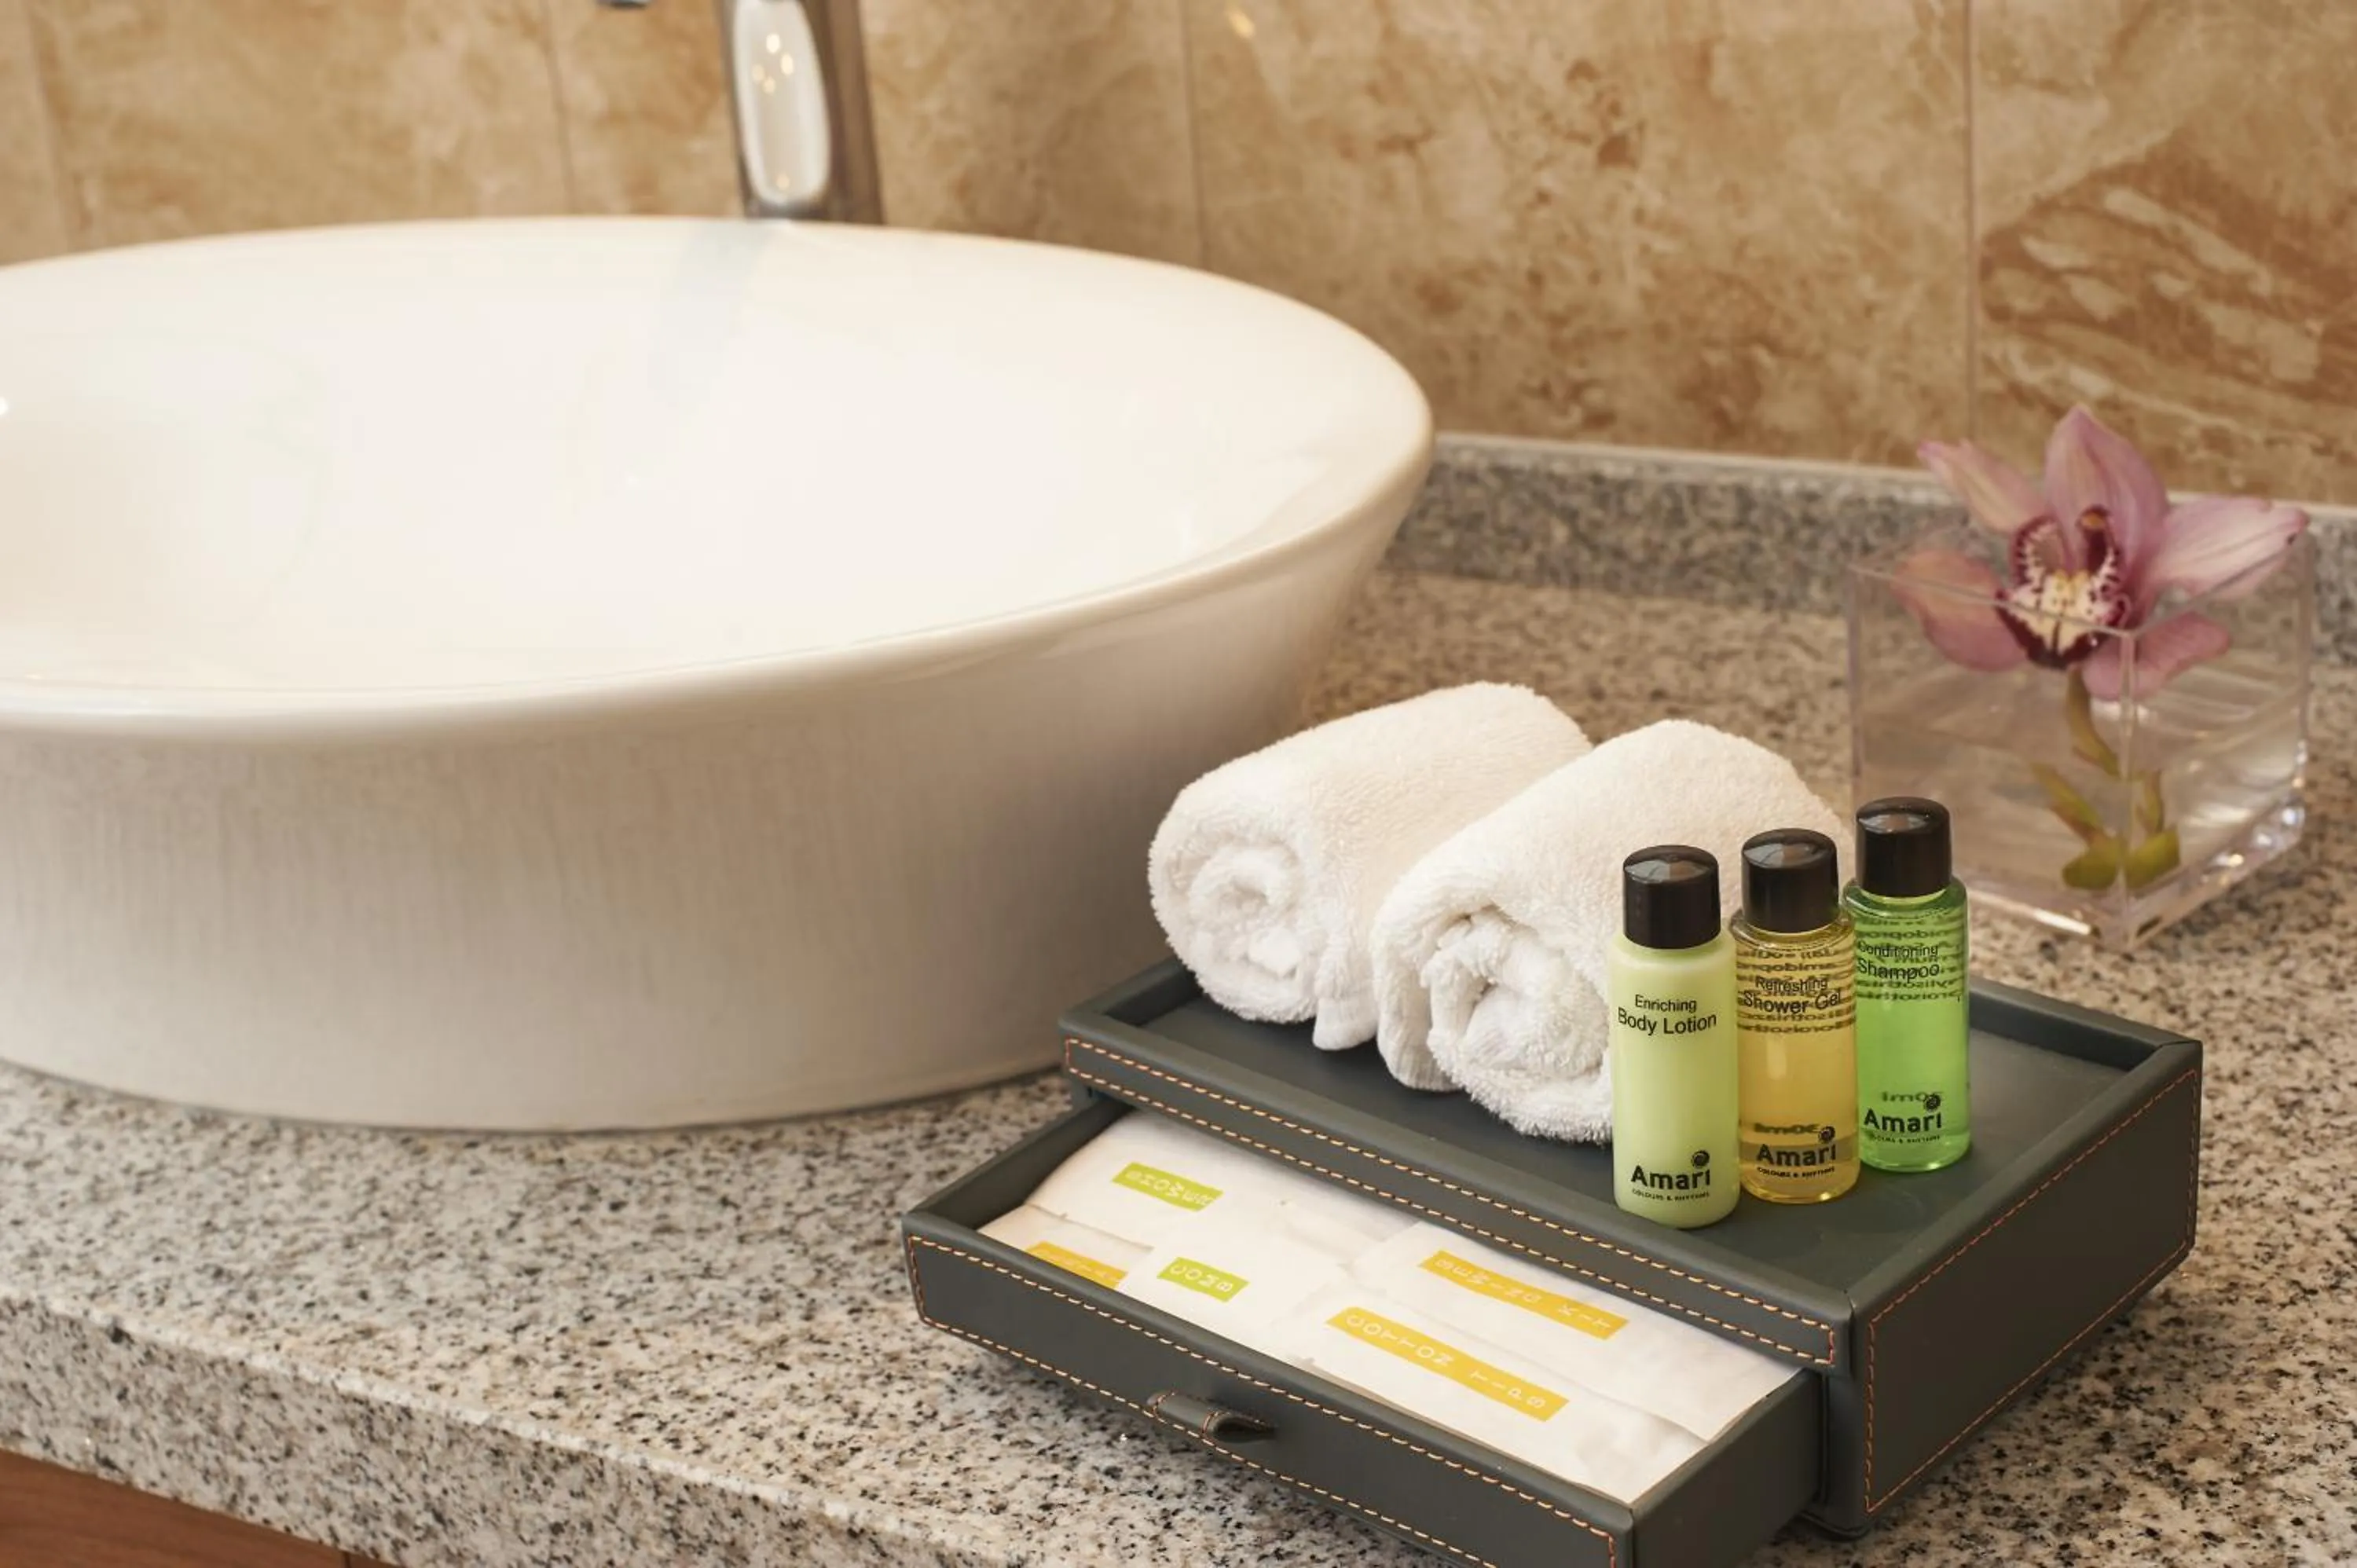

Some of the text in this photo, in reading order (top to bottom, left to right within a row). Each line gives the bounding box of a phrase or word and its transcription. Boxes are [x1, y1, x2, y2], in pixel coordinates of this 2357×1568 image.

[1857, 940, 1939, 958] Conditioning
[1754, 975, 1828, 992] Refreshing
[1857, 958, 1940, 984] Shampoo
[1634, 994, 1697, 1013] Enriching
[1743, 990, 1809, 1014] Shower
[1815, 987, 1841, 1009] Gel
[1618, 1006, 1658, 1036] Body
[1662, 1013, 1717, 1035] Lotion
[1864, 1093, 1942, 1133] Amari
[1756, 1126, 1837, 1167] Amari
[1631, 1150, 1710, 1190] Amari
[1169, 1265, 1233, 1293] COMB
[1556, 1303, 1611, 1329] KIT
[1345, 1314, 1546, 1409] COTTON TIPS
